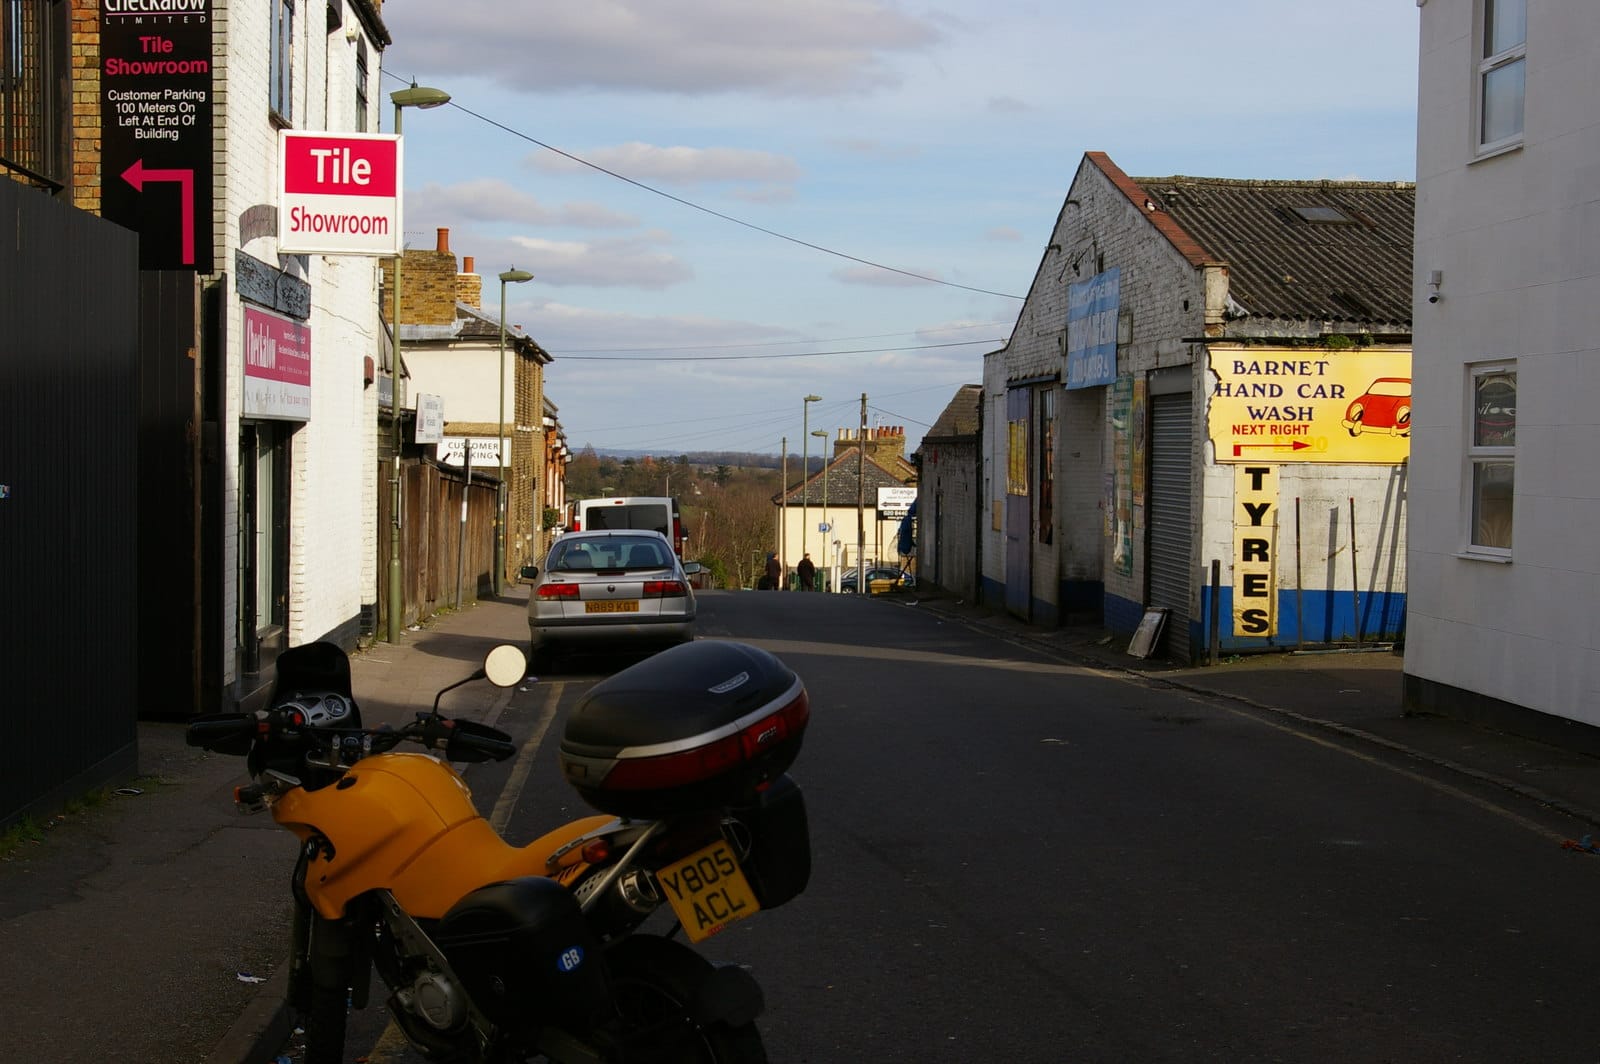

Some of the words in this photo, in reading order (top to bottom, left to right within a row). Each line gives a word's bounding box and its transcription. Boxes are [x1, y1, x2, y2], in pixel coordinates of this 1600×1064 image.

[105, 16, 206, 25] LIMITED
[139, 36, 174, 53] Tile
[105, 58, 208, 76] Showroom
[108, 89, 161, 101] Customer
[164, 88, 206, 102] Parking
[116, 102, 136, 113] 100
[138, 102, 176, 113] Meters
[179, 101, 196, 113] On
[119, 115, 140, 126] Left
[142, 115, 155, 126] At
[157, 114, 179, 126] End
[182, 114, 197, 126] Of
[135, 127, 179, 141] Building
[310, 147, 372, 185] Tile
[290, 205, 388, 235] Showroom
[1233, 360, 1329, 376] BARNET
[1215, 382, 1284, 398] HAND
[1297, 383, 1346, 399] CAR
[1246, 405, 1314, 421] WASH
[1232, 424, 1266, 435] NEXT
[1270, 424, 1310, 435] RIGHT
[448, 441, 499, 450] CUSOMER
[453, 451, 494, 460] PAKING
[1241, 467, 1272, 634] TYRES
[663, 847, 736, 900] Y805
[693, 887, 746, 930] ACL
[562, 948, 581, 970] GB
